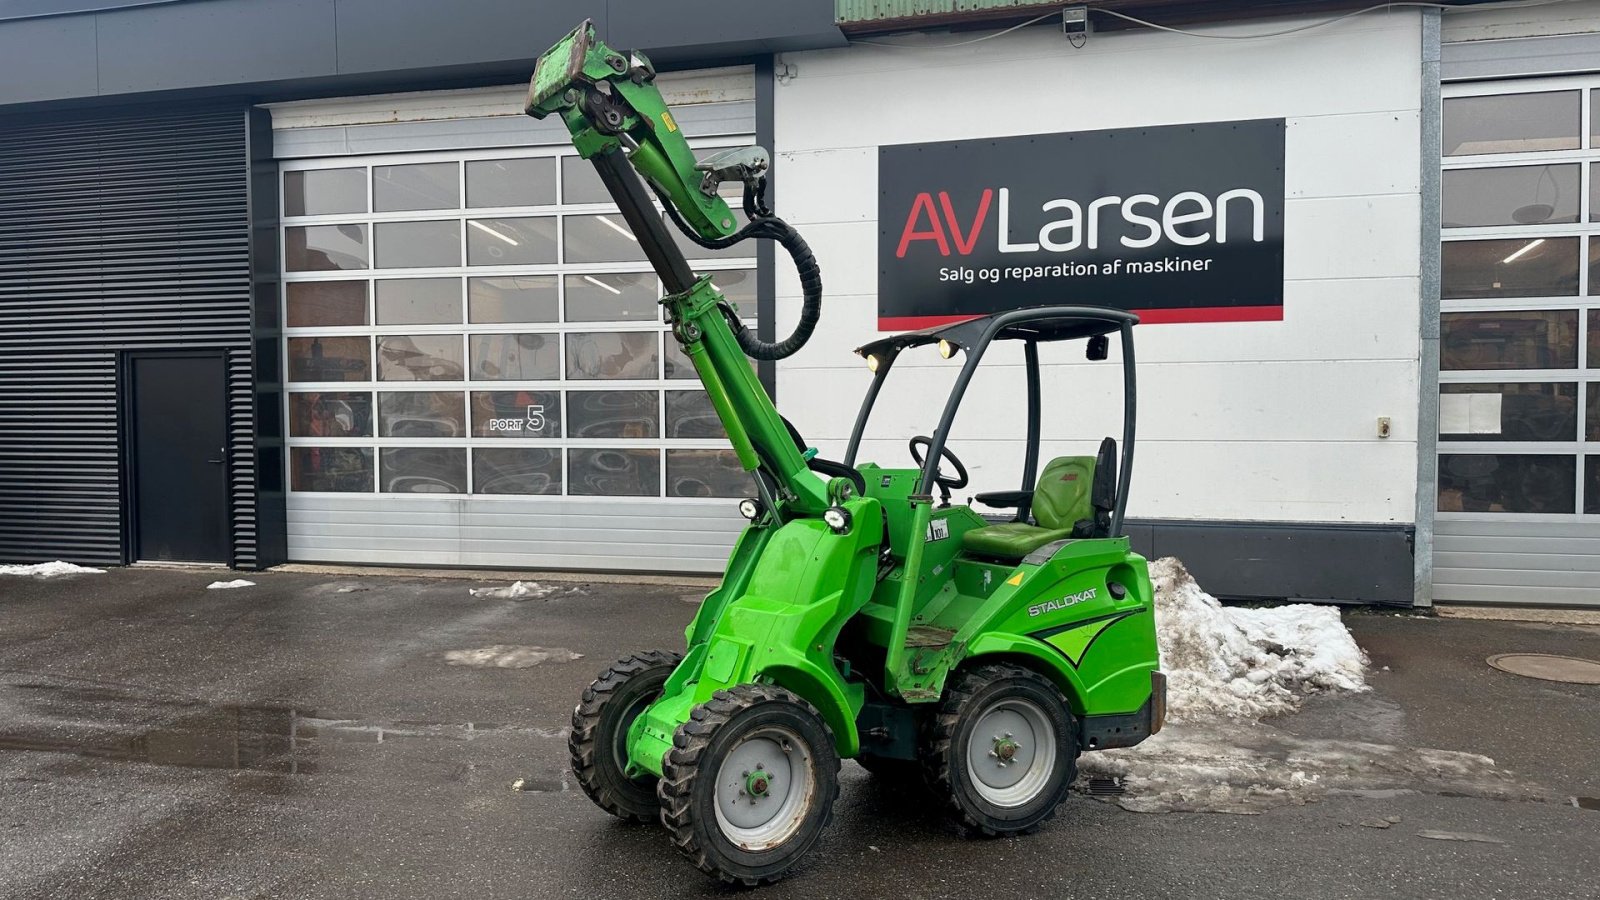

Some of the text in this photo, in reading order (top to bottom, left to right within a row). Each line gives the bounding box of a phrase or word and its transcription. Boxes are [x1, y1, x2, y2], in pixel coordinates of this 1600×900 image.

[939, 256, 1213, 284] Salg og reparation af maskiner
[490, 405, 545, 431] PORT 5
[1028, 588, 1097, 617] STALDKAT
